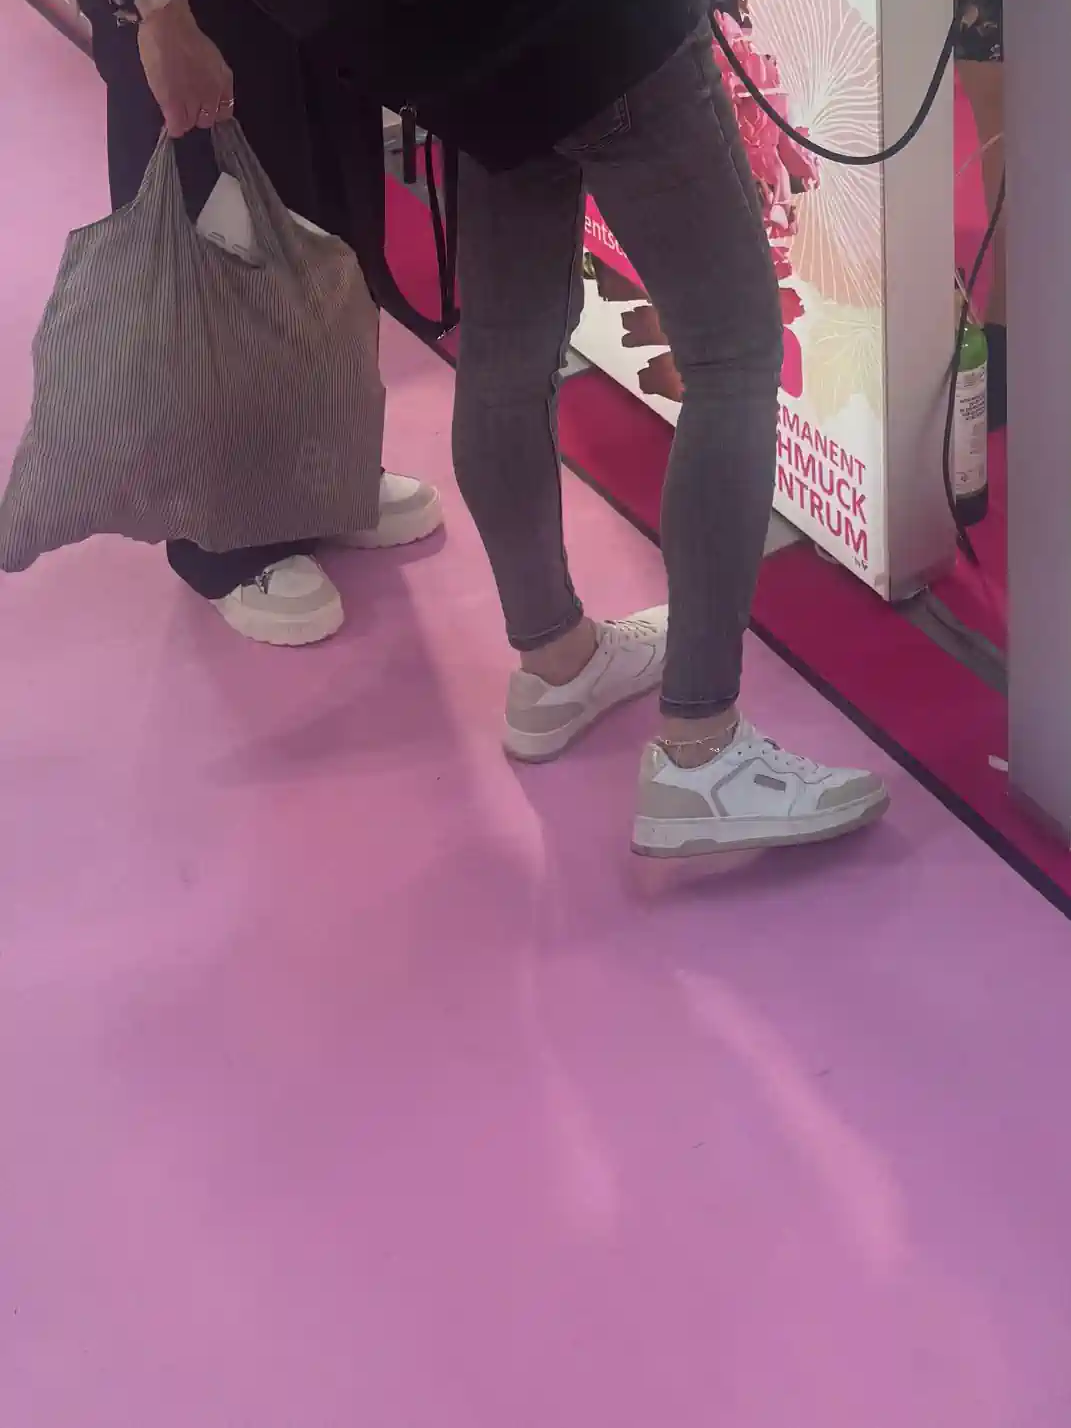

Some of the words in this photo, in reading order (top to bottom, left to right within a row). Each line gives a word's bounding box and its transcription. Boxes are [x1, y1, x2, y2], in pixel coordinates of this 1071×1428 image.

[776, 429, 868, 525] HMUCK
[777, 404, 867, 486] MANENT
[777, 463, 868, 561] NTRUM
